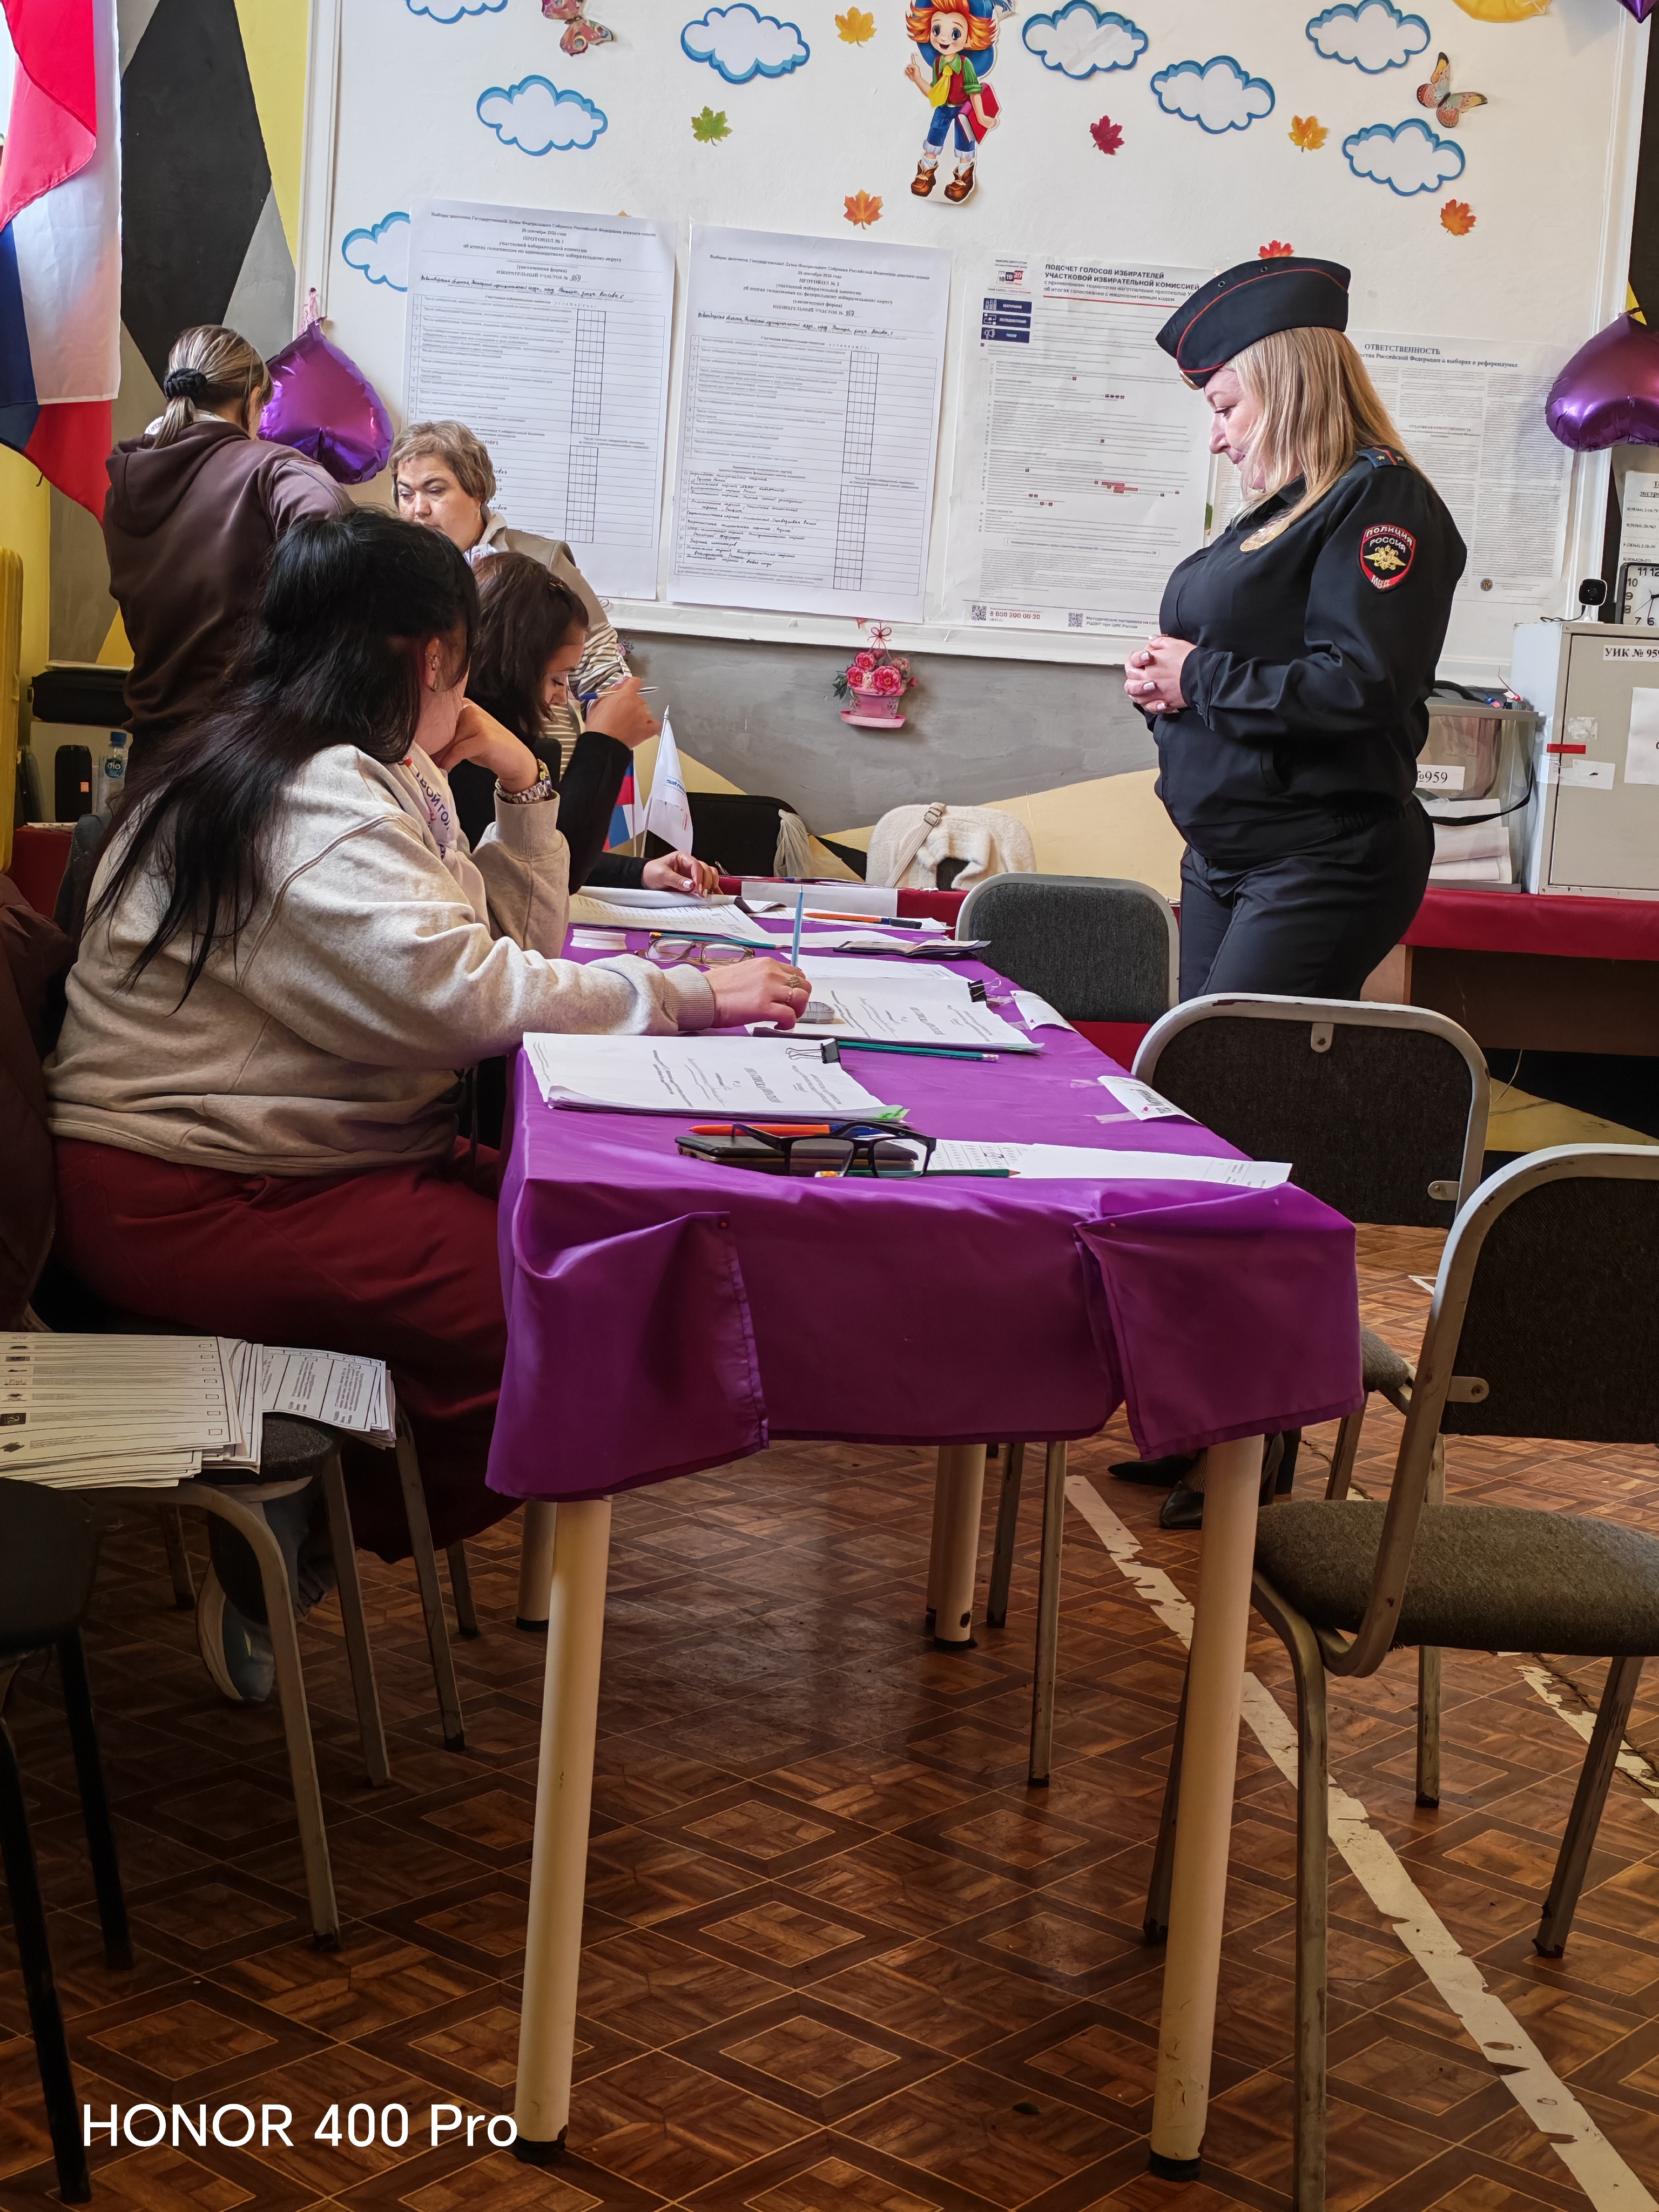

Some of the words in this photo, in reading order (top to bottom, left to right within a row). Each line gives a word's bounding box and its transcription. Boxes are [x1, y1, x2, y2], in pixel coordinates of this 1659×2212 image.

[1045, 264, 1078, 273] ПОДСЧЕТ
[1080, 266, 1112, 275] ГОЛОСОВ
[1114, 269, 1164, 279] ИЗБИРАТЕЛЕЙ
[1045, 272, 1092, 282] УЧАСТКОВОЙ
[1094, 275, 1154, 287] ИЗБИРАТЕЛЬНОЙ
[1155, 281, 1199, 291] КОМИССИЕЙ
[1364, 343, 1440, 355] ОТВЕТСТВЕННОСТЬ
[1366, 526, 1413, 546] ПОЛИЦИЯ
[1370, 537, 1406, 553] РОССИЯ
[1637, 568, 1647, 576] 11
[1650, 568, 1659, 576] 12
[1371, 575, 1390, 588] МВД
[1627, 578, 1638, 587] 10
[1626, 592, 1633, 601] 9
[1624, 605, 1631, 614] 8
[1635, 617, 1642, 625] 7
[1647, 617, 1654, 625] 6
[1604, 648, 1630, 657] УИК
[1632, 649, 1644, 658] №
[1647, 649, 1659, 658] 95
